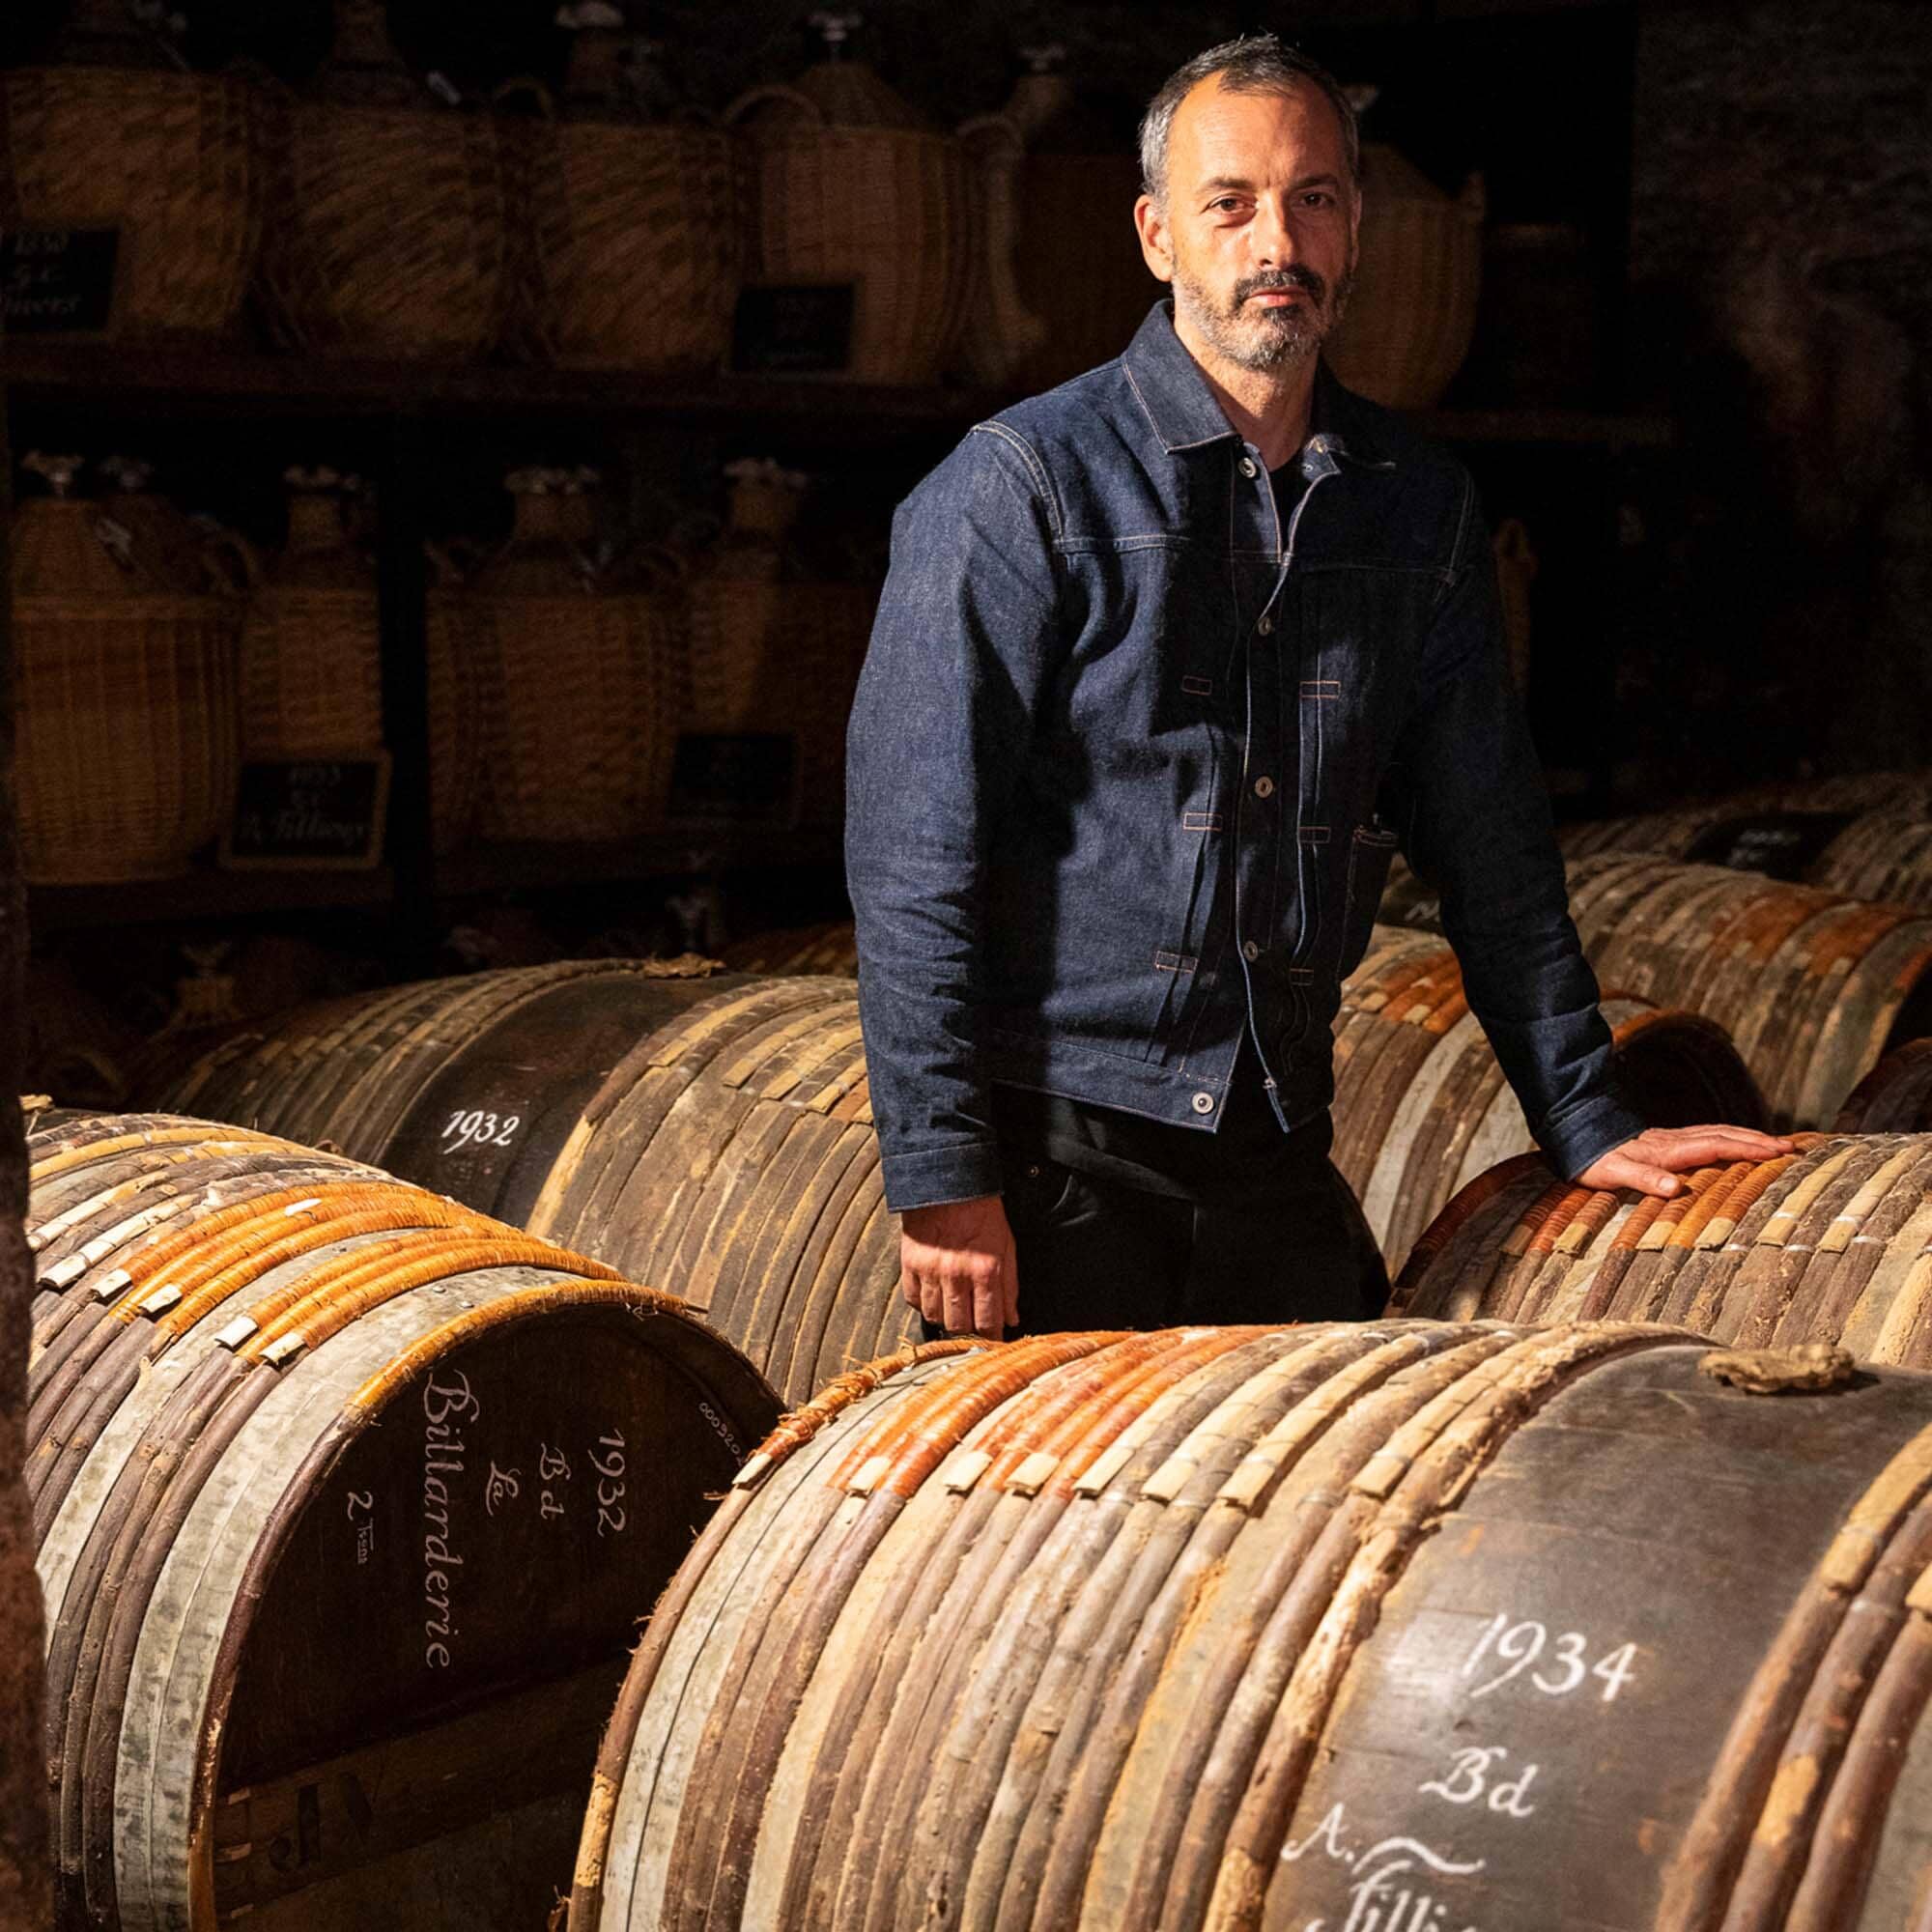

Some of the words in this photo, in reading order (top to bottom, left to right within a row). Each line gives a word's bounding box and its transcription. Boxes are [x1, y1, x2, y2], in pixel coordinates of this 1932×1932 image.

[441, 1110, 520, 1154] 1932
[346, 1491, 374, 1522] 2
[485, 1460, 522, 1517] La
[587, 1428, 626, 1538] 1932
[422, 1368, 480, 1670] Billarderie
[1462, 1612, 1637, 1702] 1934
[1418, 1746, 1540, 1817] Bd
